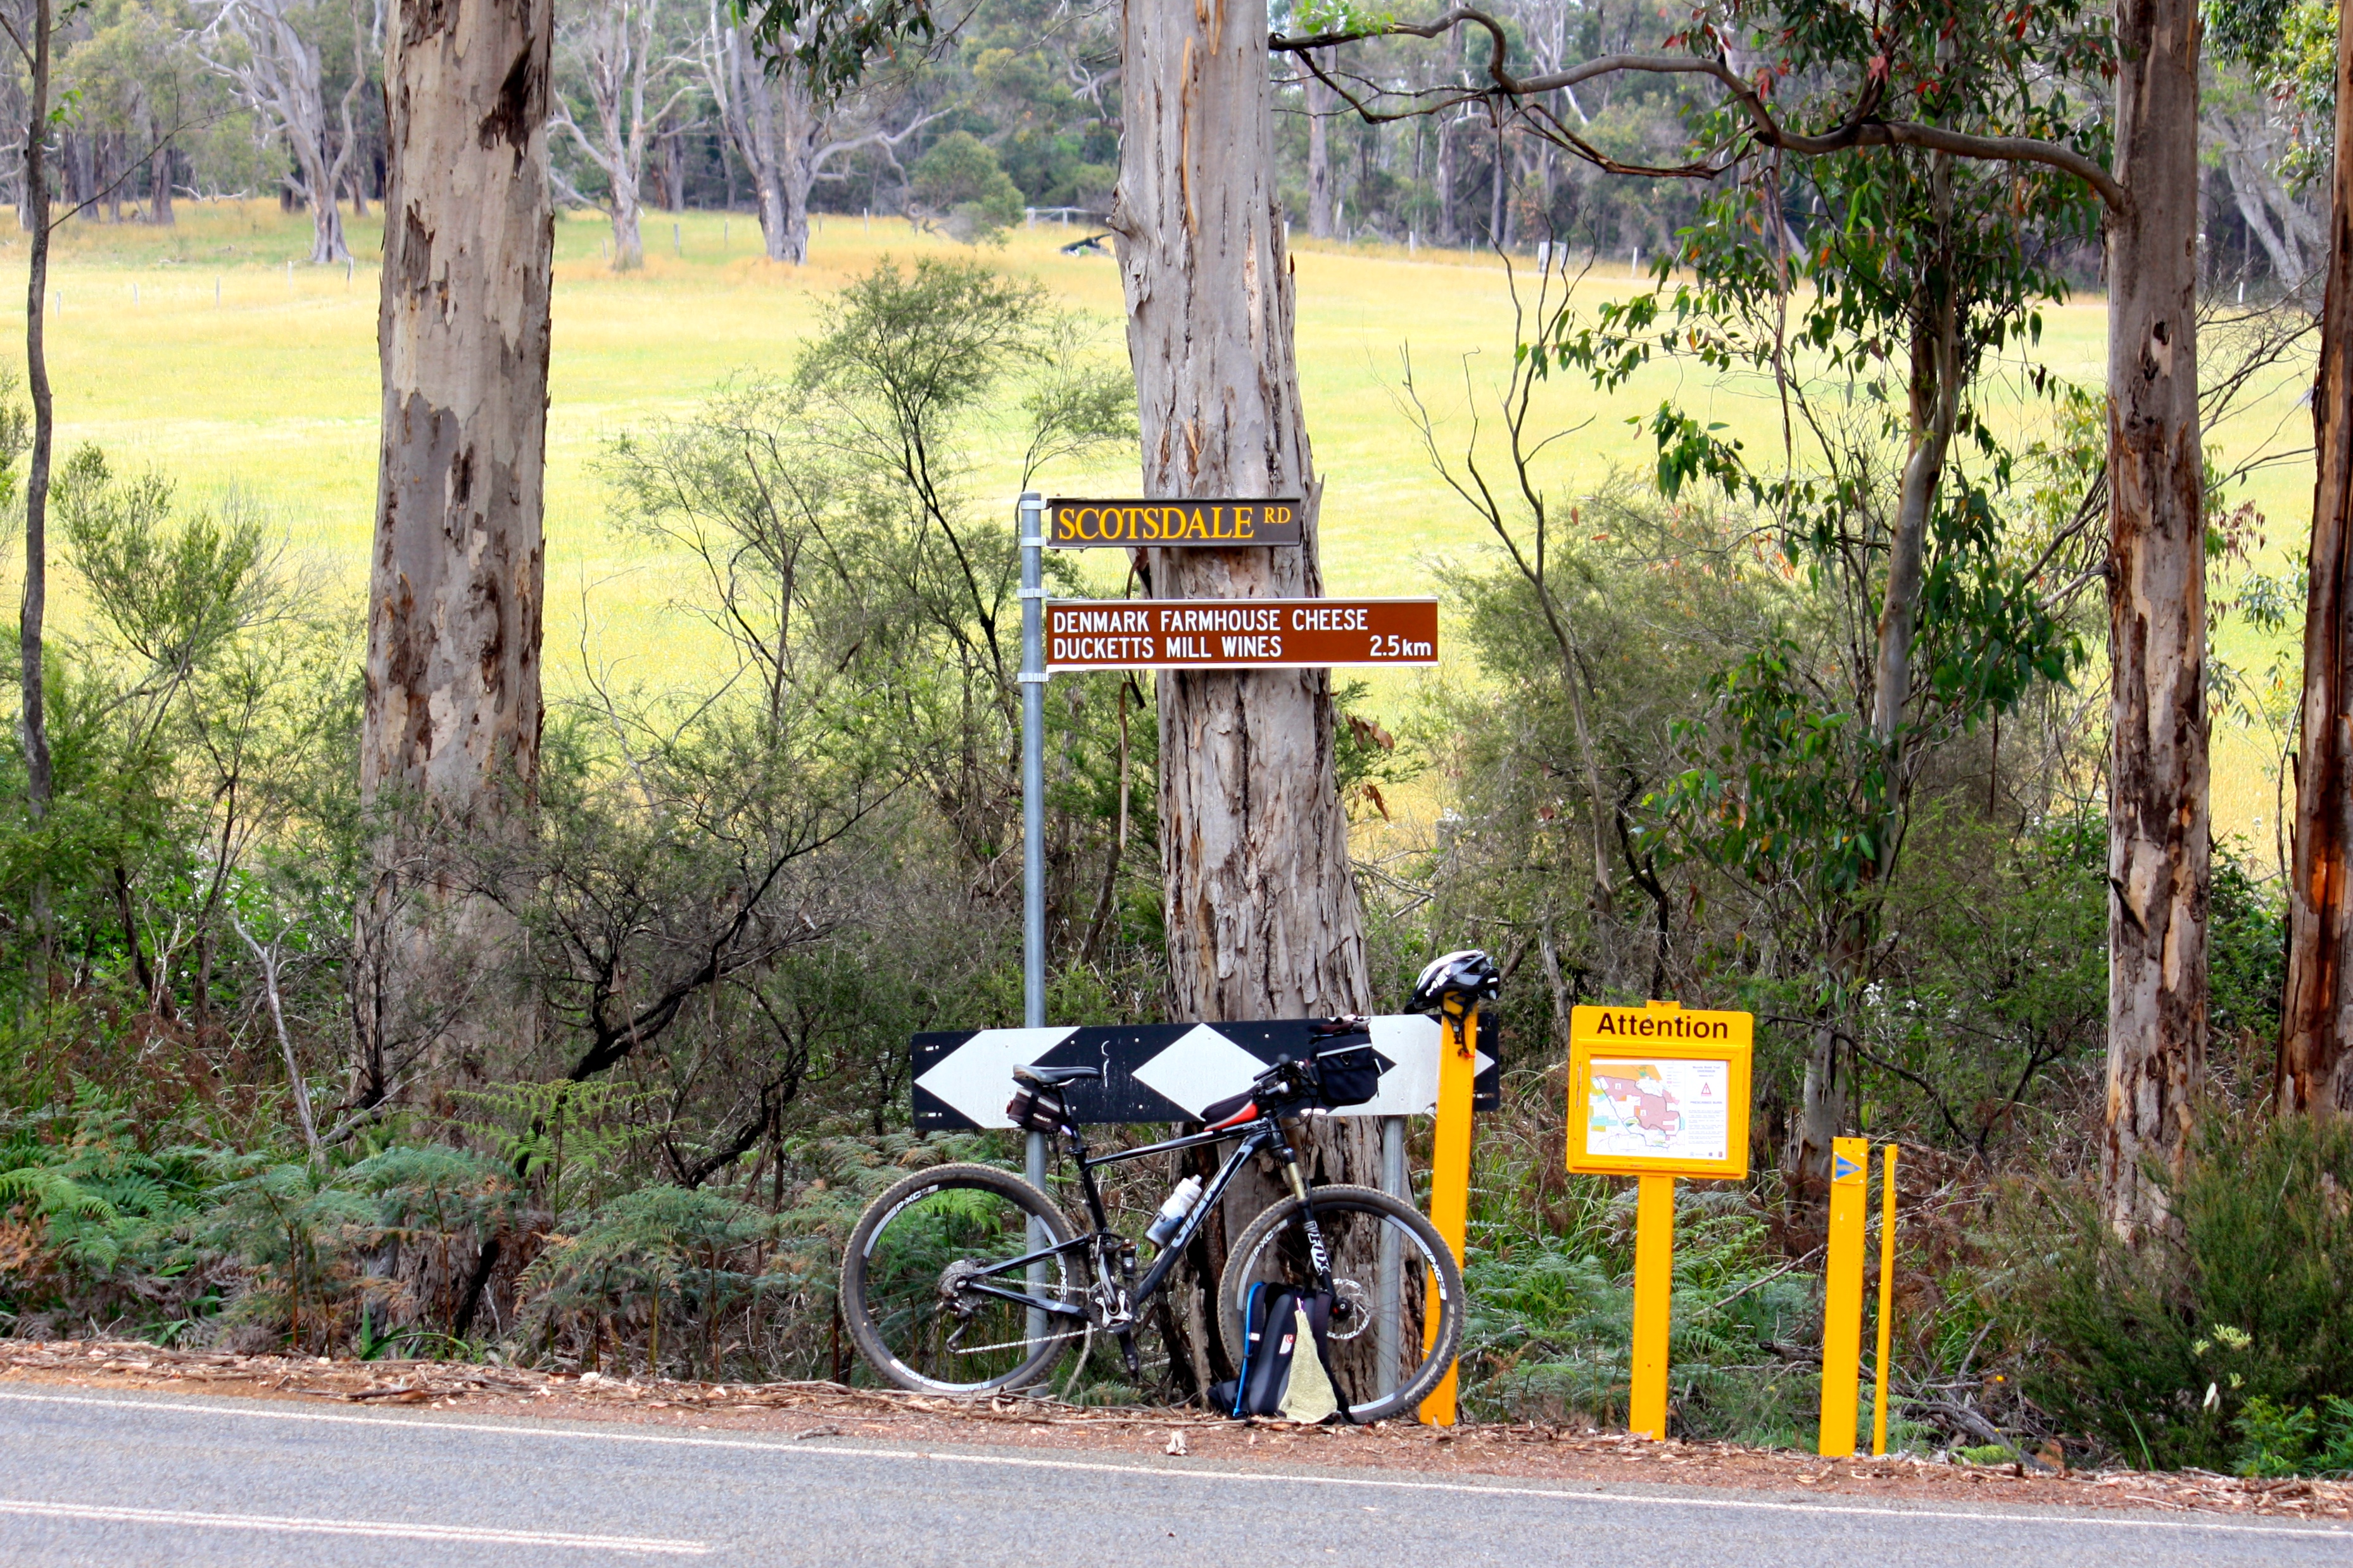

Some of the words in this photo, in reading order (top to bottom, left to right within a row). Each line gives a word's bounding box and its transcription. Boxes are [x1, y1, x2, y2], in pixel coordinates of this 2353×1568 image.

[1059, 507, 1254, 539] SCOTSDALE
[1263, 507, 1292, 524] RD
[1053, 611, 1150, 633] DENMARK
[1160, 610, 1281, 632] FARMHOUSE
[1292, 609, 1368, 630] CHEESE
[1053, 637, 1154, 659] DUCKETTS
[1166, 637, 1212, 658] MILL
[1221, 636, 1282, 657] WINES
[1425, 964, 1452, 996] MET
[1596, 1013, 1728, 1039] Attention
[1033, 1113, 1051, 1123] GIANT
[1308, 1233, 1331, 1276] FOX
[1404, 1363, 1439, 1401] RACING
[1437, 1317, 1455, 1362] RALPH
